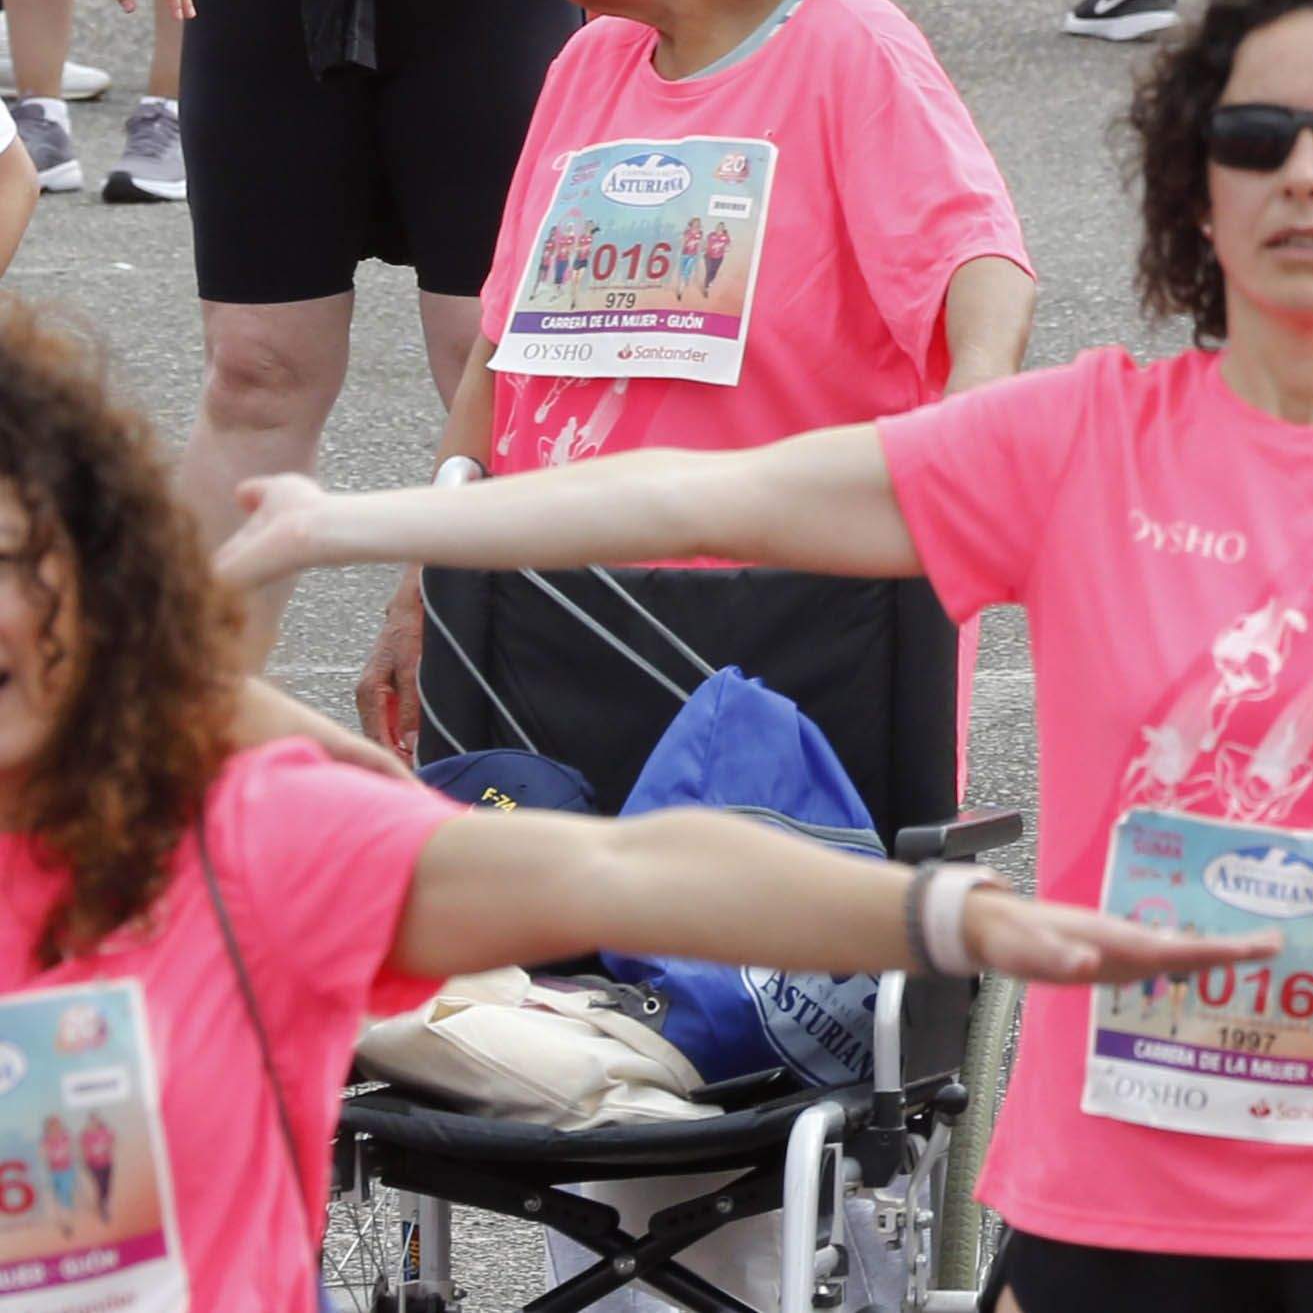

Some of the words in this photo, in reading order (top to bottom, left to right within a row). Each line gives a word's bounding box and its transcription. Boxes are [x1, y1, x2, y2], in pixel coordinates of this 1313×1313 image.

[721, 154, 747, 173] 20
[592, 242, 672, 281] 016
[605, 292, 636, 309] 979
[540, 315, 588, 330] CARRERA
[589, 315, 603, 329] DE
[607, 315, 621, 328] LA
[622, 314, 657, 328] MUJER
[522, 342, 594, 362] OYSHO
[633, 345, 709, 363] Santander
[762, 970, 875, 1080] ASTURIAN
[1218, 1026, 1277, 1053] 1997
[1133, 1040, 1197, 1068] CARRERA
[1199, 1048, 1221, 1071] DE
[1225, 1052, 1248, 1076] LA
[1251, 1057, 1308, 1080] MUJER
[1114, 1074, 1208, 1113] OYSHO
